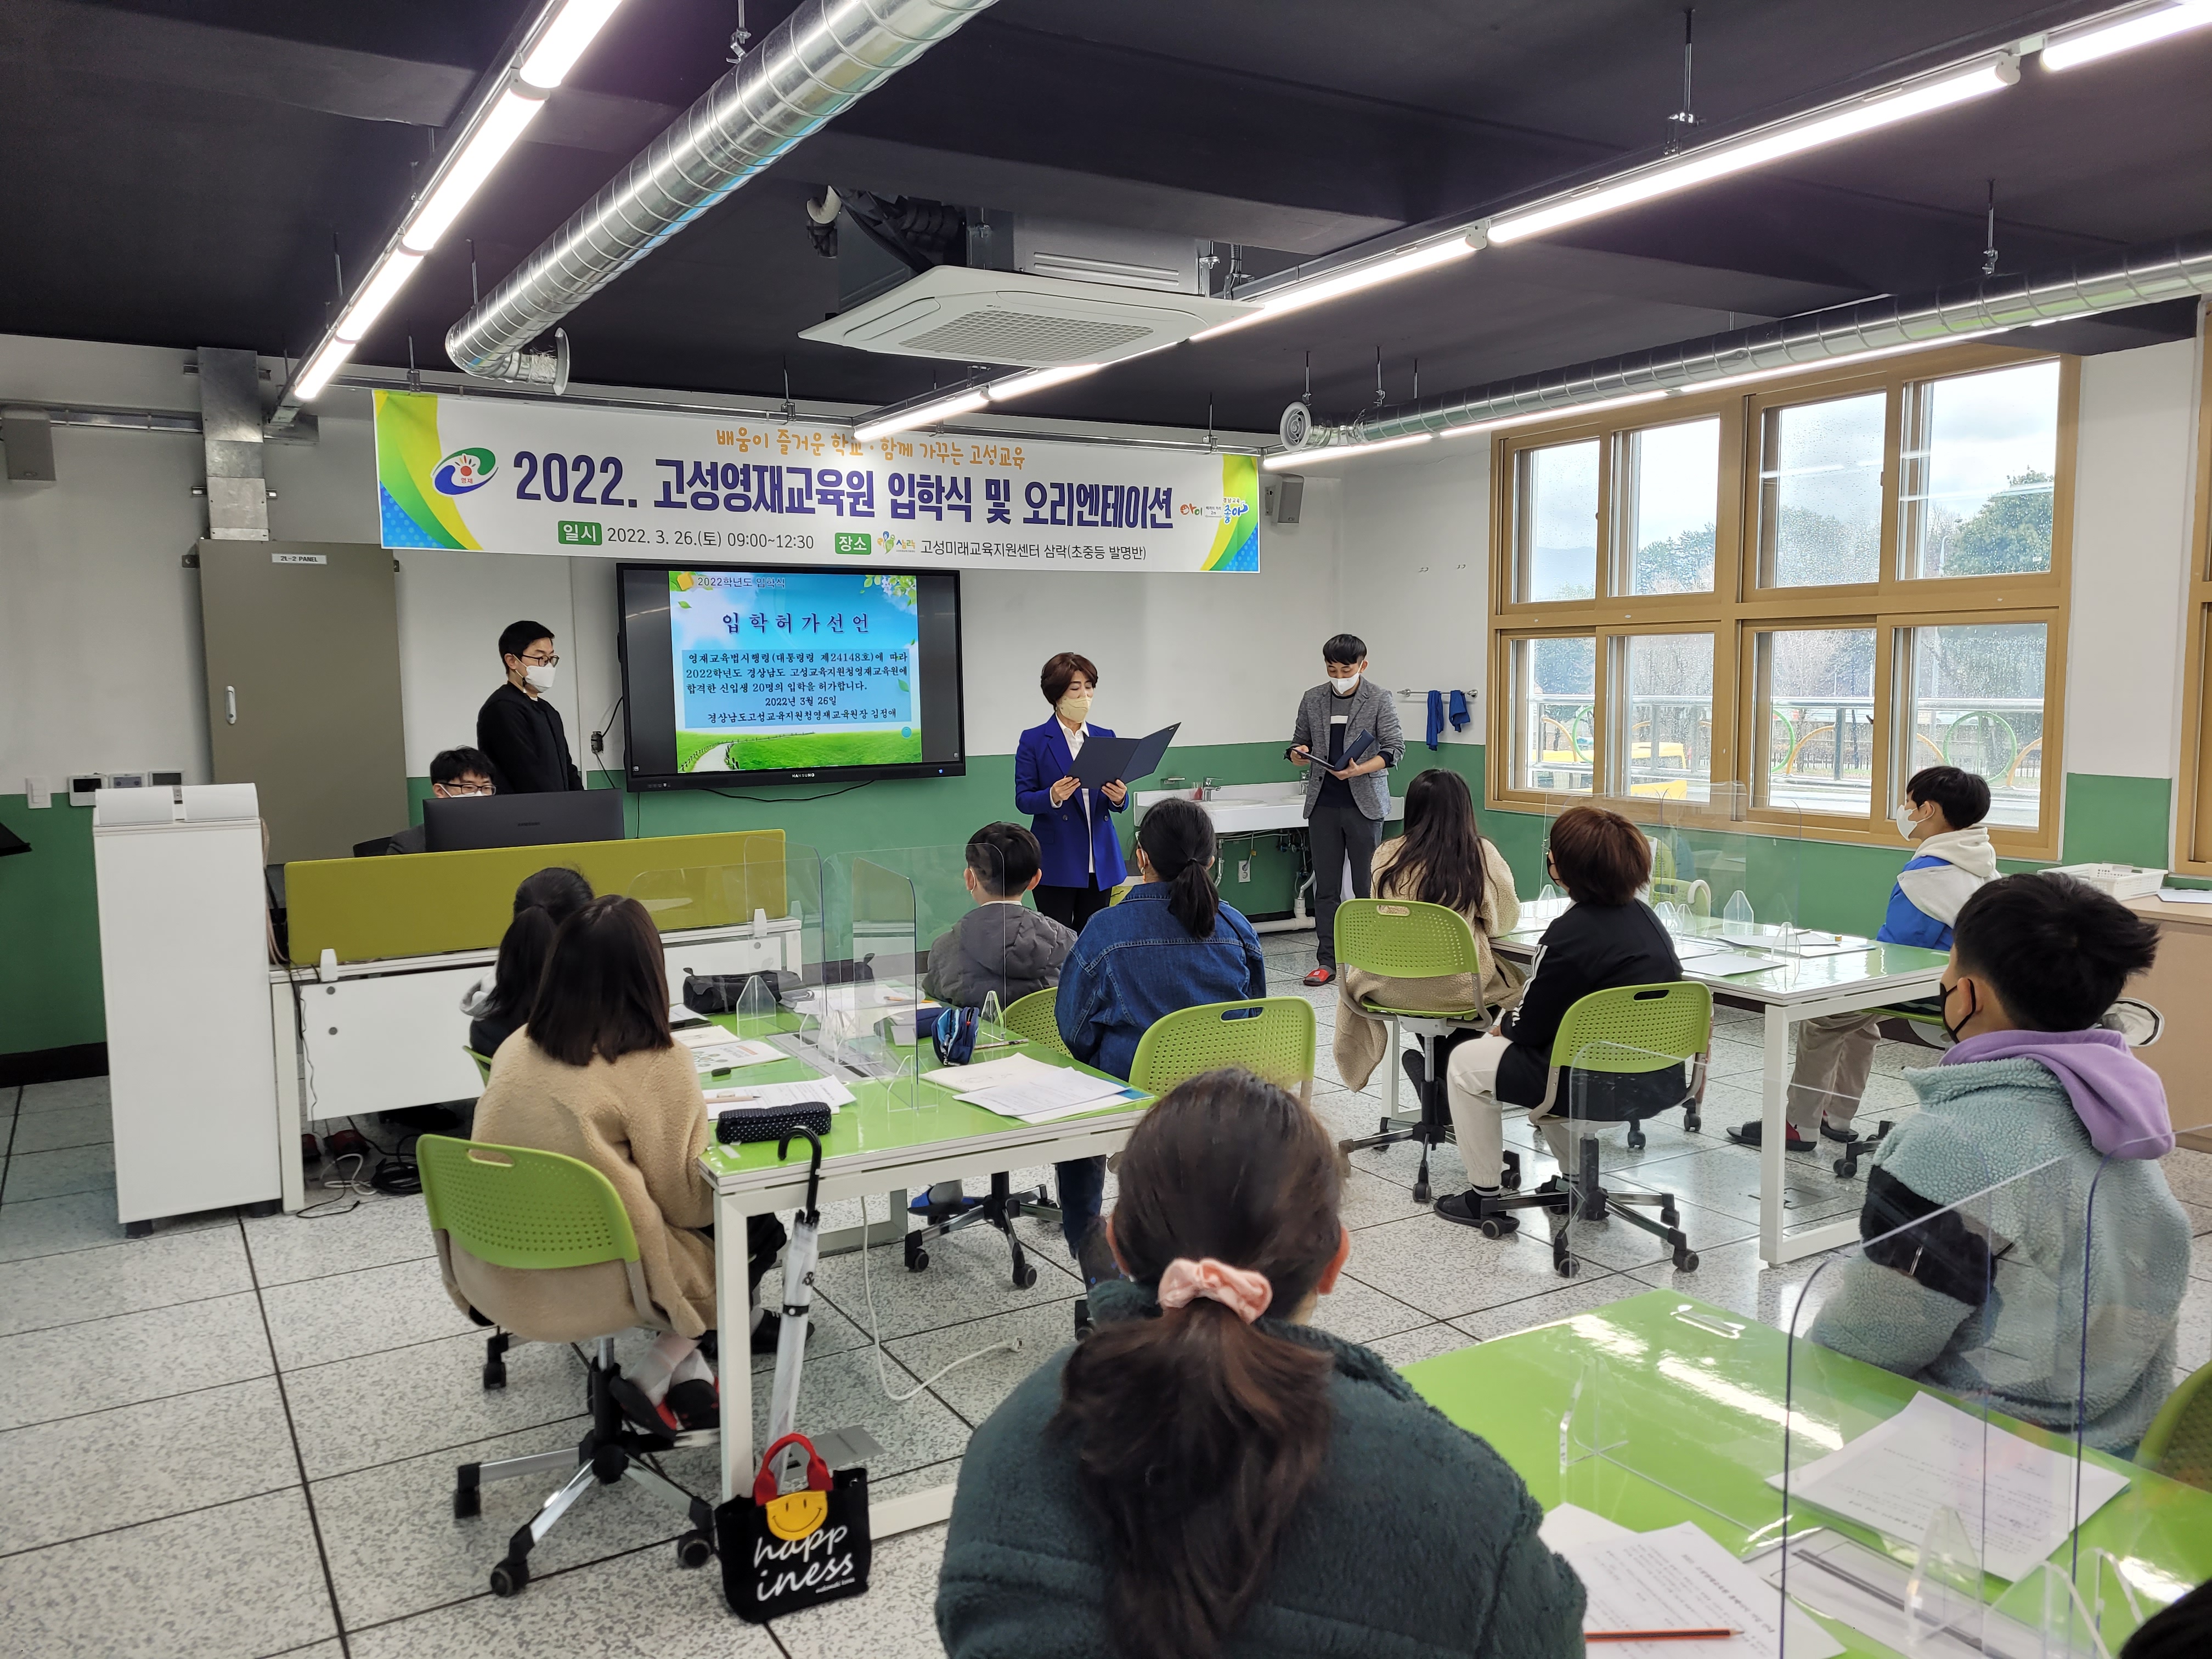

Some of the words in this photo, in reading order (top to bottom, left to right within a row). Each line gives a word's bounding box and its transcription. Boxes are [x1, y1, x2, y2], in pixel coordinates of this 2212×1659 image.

[716, 427, 769, 452] 배움이
[776, 429, 825, 456] 즐거운
[831, 433, 863, 456] 학교
[880, 437, 913, 460] 함께
[919, 442, 964, 465] 가꾸는
[969, 444, 1025, 470] 고성교육
[514, 451, 637, 508] 2022.
[654, 459, 875, 517] 고성영재교육원
[888, 472, 972, 522] 입학식
[985, 478, 1011, 524] 및
[1023, 481, 1173, 529] 오리엔테이션
[1224, 504, 1249, 524] 좋아
[563, 524, 596, 543] 일시
[607, 527, 650, 544] 2022.
[656, 530, 669, 545] 3.
[674, 531, 721, 548] 26.(토)
[727, 533, 814, 549] 09:00~12:30
[838, 535, 867, 552] 장소
[921, 540, 1040, 558] 고성미래교육지원센터
[1044, 544, 1105, 560] 삼락(초중등
[1109, 546, 1147, 561] 발명반)
[697, 577, 753, 588] 2022학년도
[757, 578, 785, 588] 입학식
[689, 652, 814, 664] 영재교육법시행령(대통령령
[821, 652, 883, 663] 제24148호)에
[890, 652, 907, 662] 따라
[686, 668, 742, 679] 2022학년도
[747, 668, 786, 678] 경상남도
[790, 666, 907, 678] 고성교육지원청영재교육원에
[686, 684, 716, 694] 합격한
[719, 683, 748, 693] 신입생
[753, 682, 783, 692] 20명의
[788, 681, 815, 692] 입학을
[818, 681, 867, 691] 허가합니다.
[765, 696, 795, 707] 2022년
[800, 696, 813, 706] 3월
[817, 696, 836, 706] 26일
[708, 709, 868, 724] 경상남도고성교육지원청영재교육원장
[871, 708, 896, 719] 김정애
[754, 1525, 848, 1568] happ
[757, 1553, 854, 1601] iness
